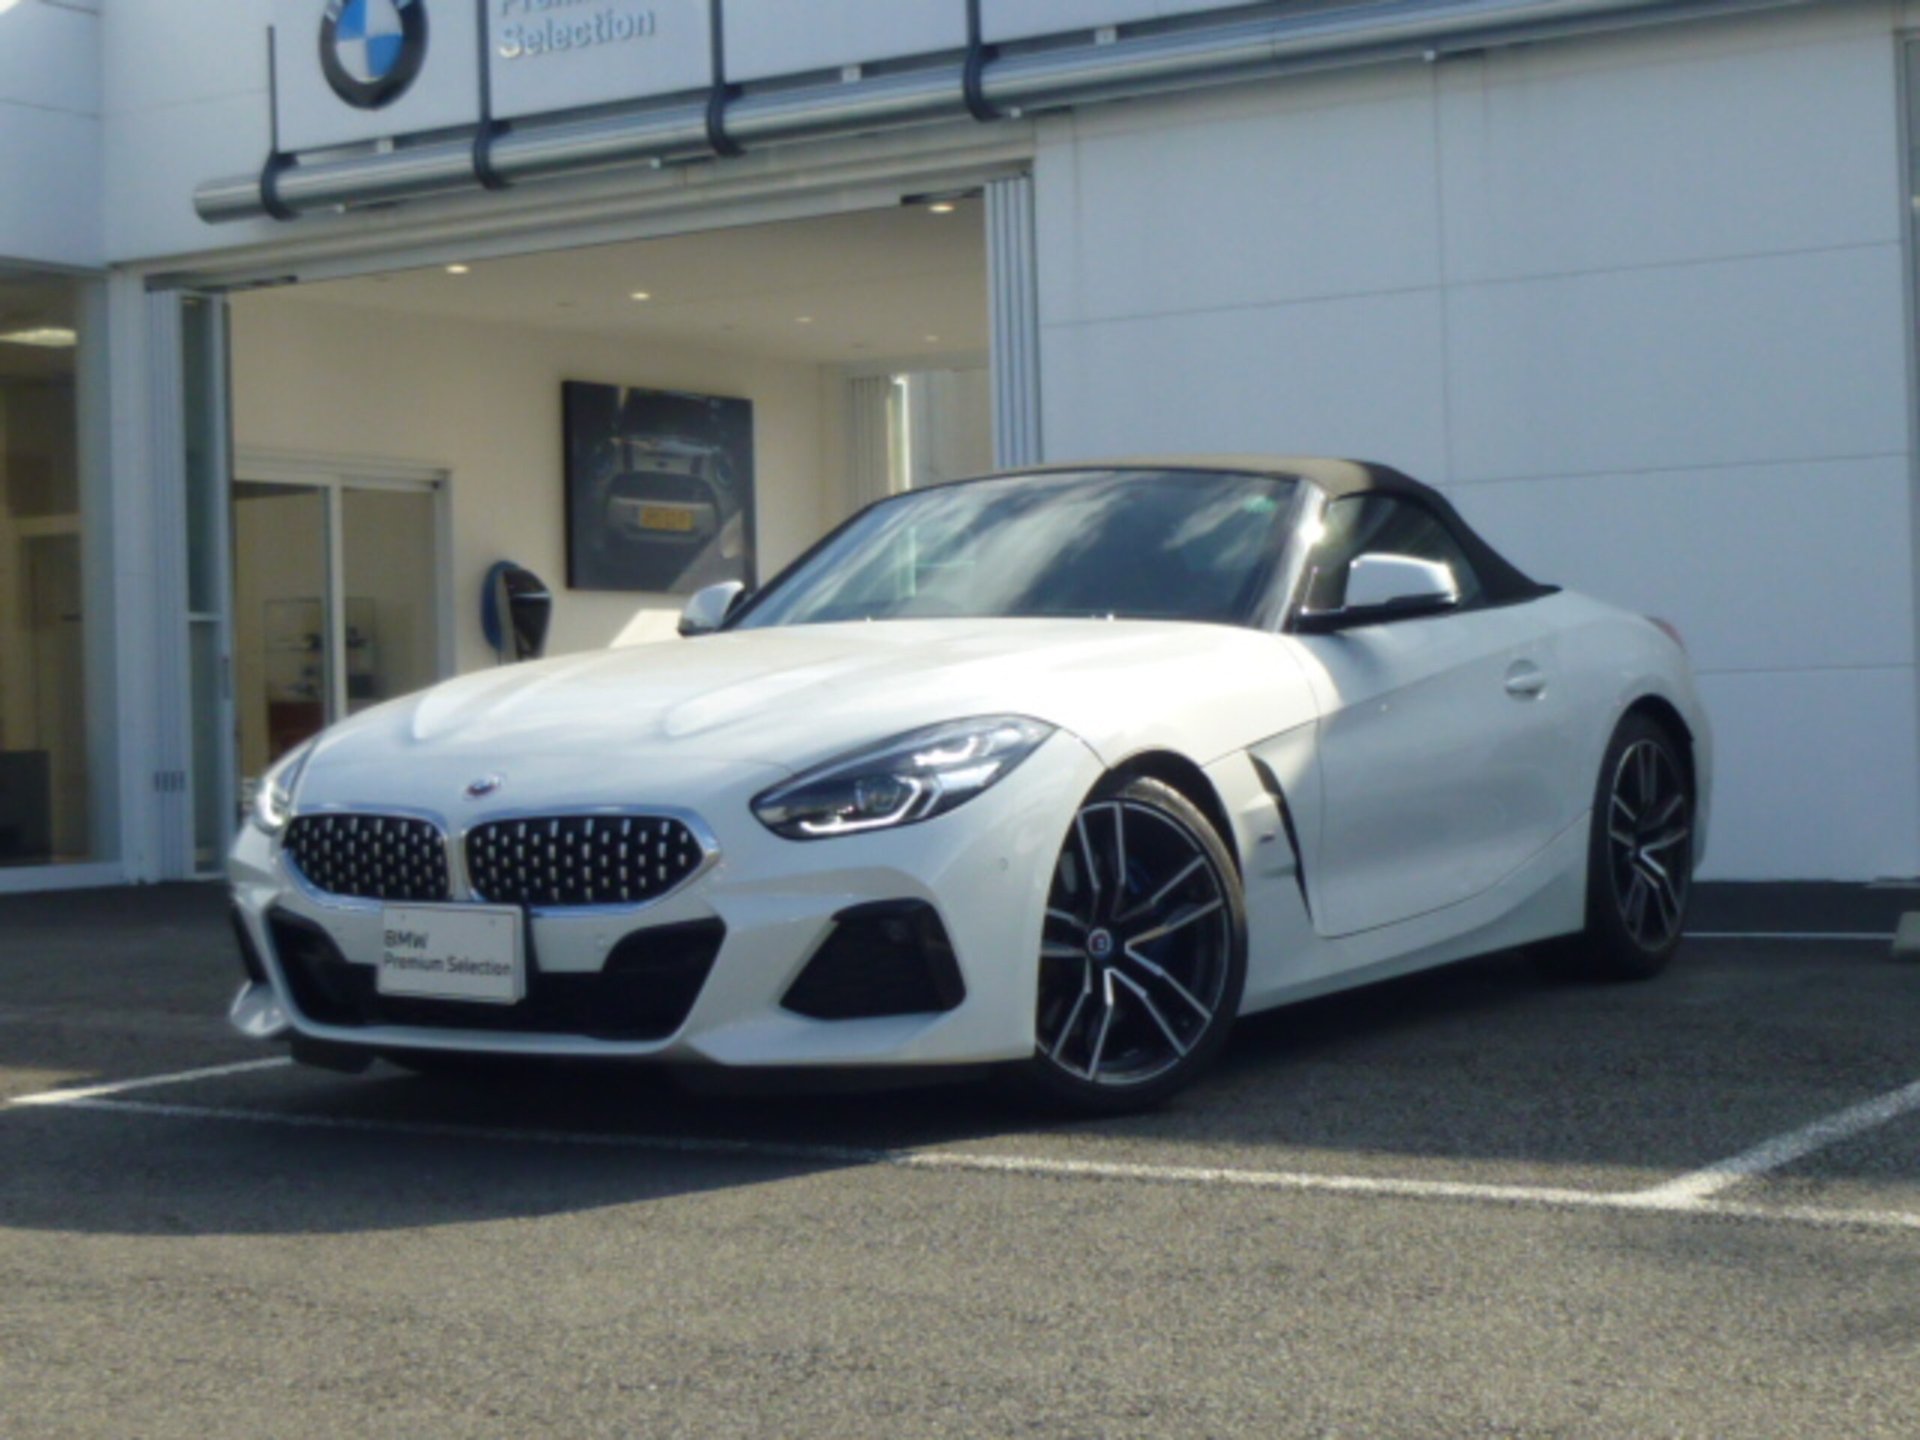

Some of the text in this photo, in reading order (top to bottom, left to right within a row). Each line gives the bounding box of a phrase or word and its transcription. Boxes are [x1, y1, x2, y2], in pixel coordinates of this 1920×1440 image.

[500, 9, 656, 58] Selection
[384, 929, 429, 949] BMW
[384, 951, 512, 976] Premium Selection
